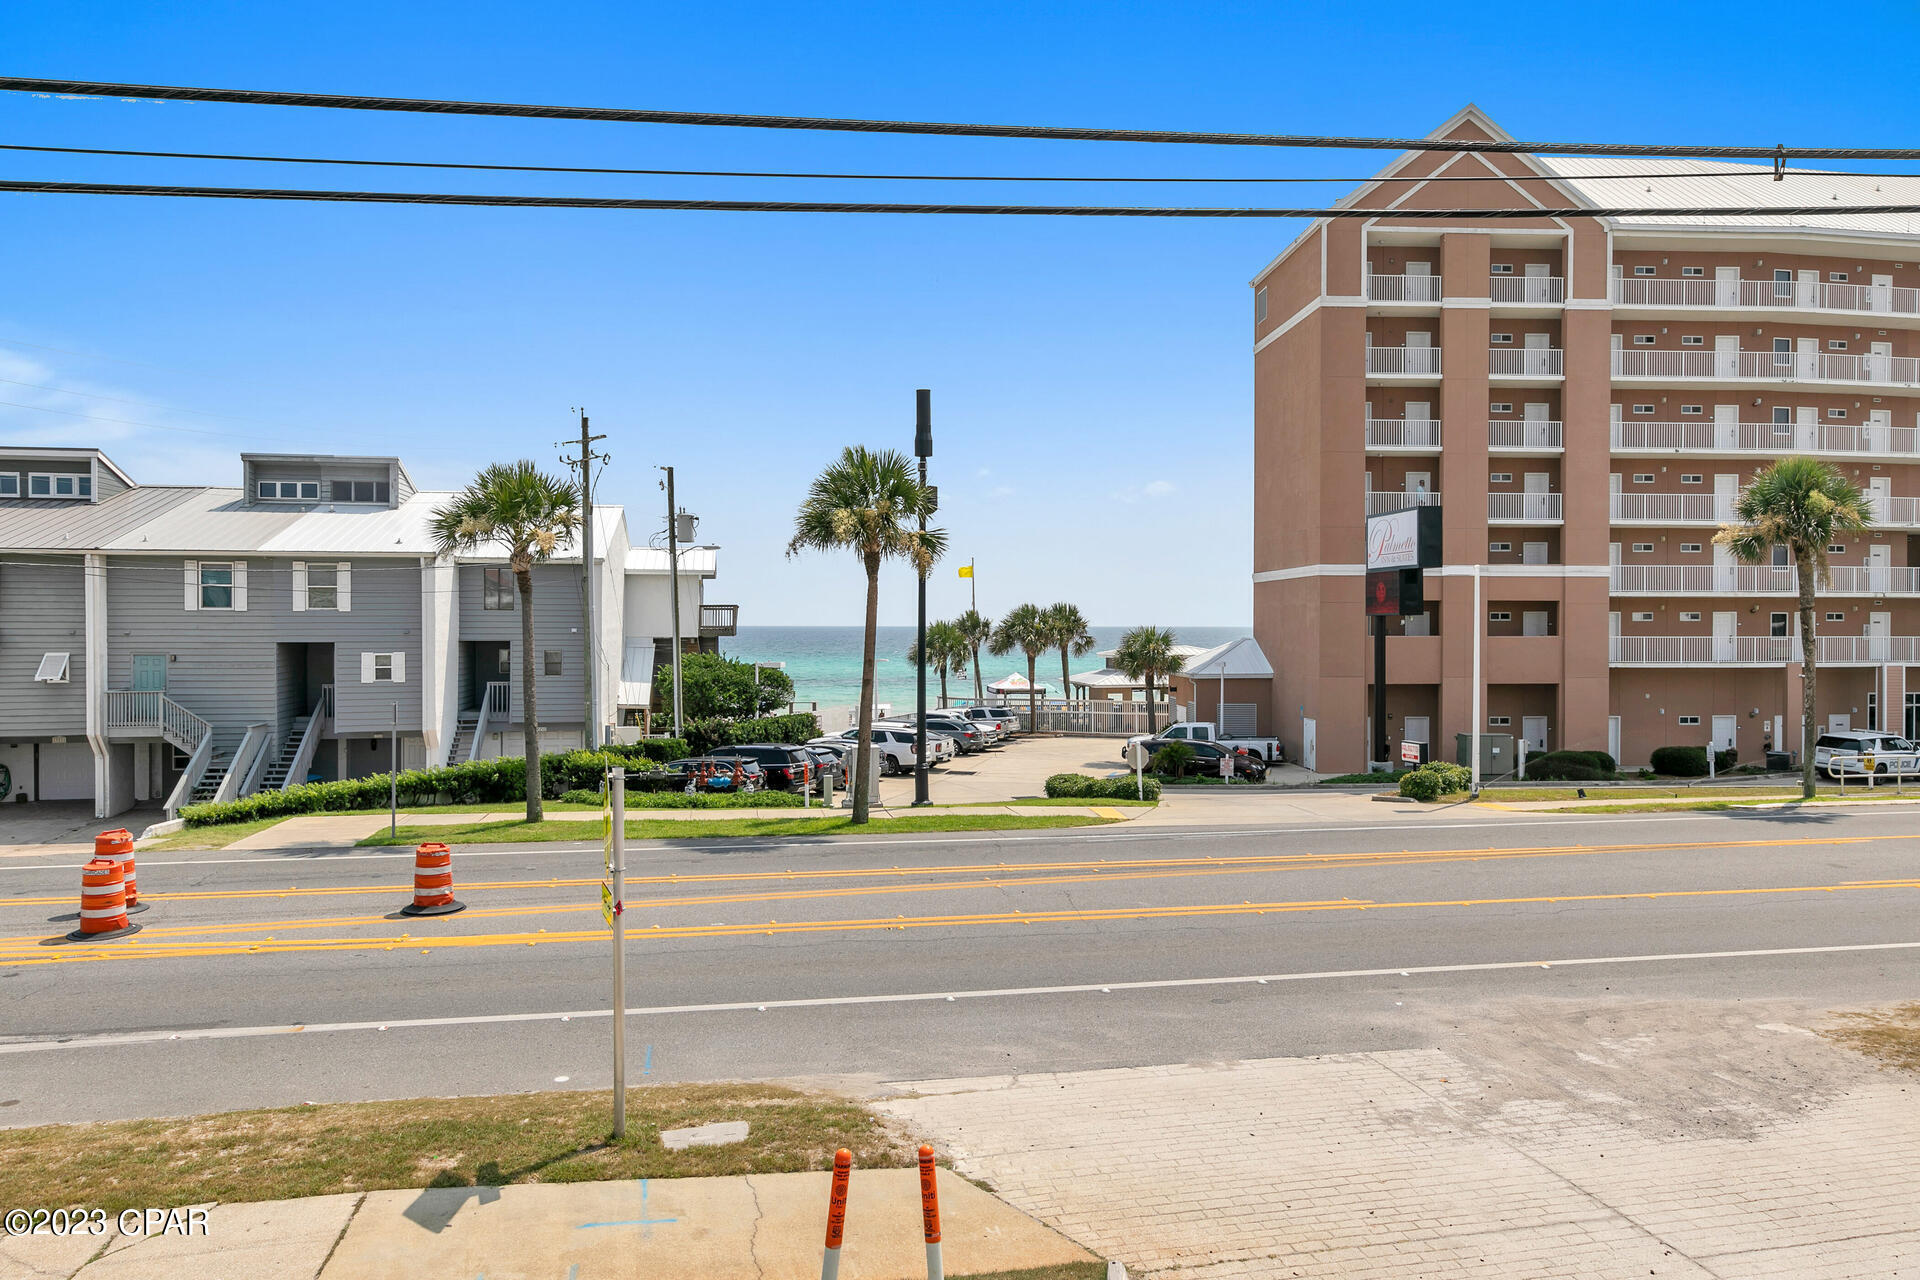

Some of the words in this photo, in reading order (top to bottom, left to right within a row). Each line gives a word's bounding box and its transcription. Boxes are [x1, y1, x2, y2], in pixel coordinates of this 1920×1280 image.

[1369, 519, 1416, 562] Palmetto
[1889, 760, 1911, 769] POICE
[831, 1196, 847, 1206] Unit
